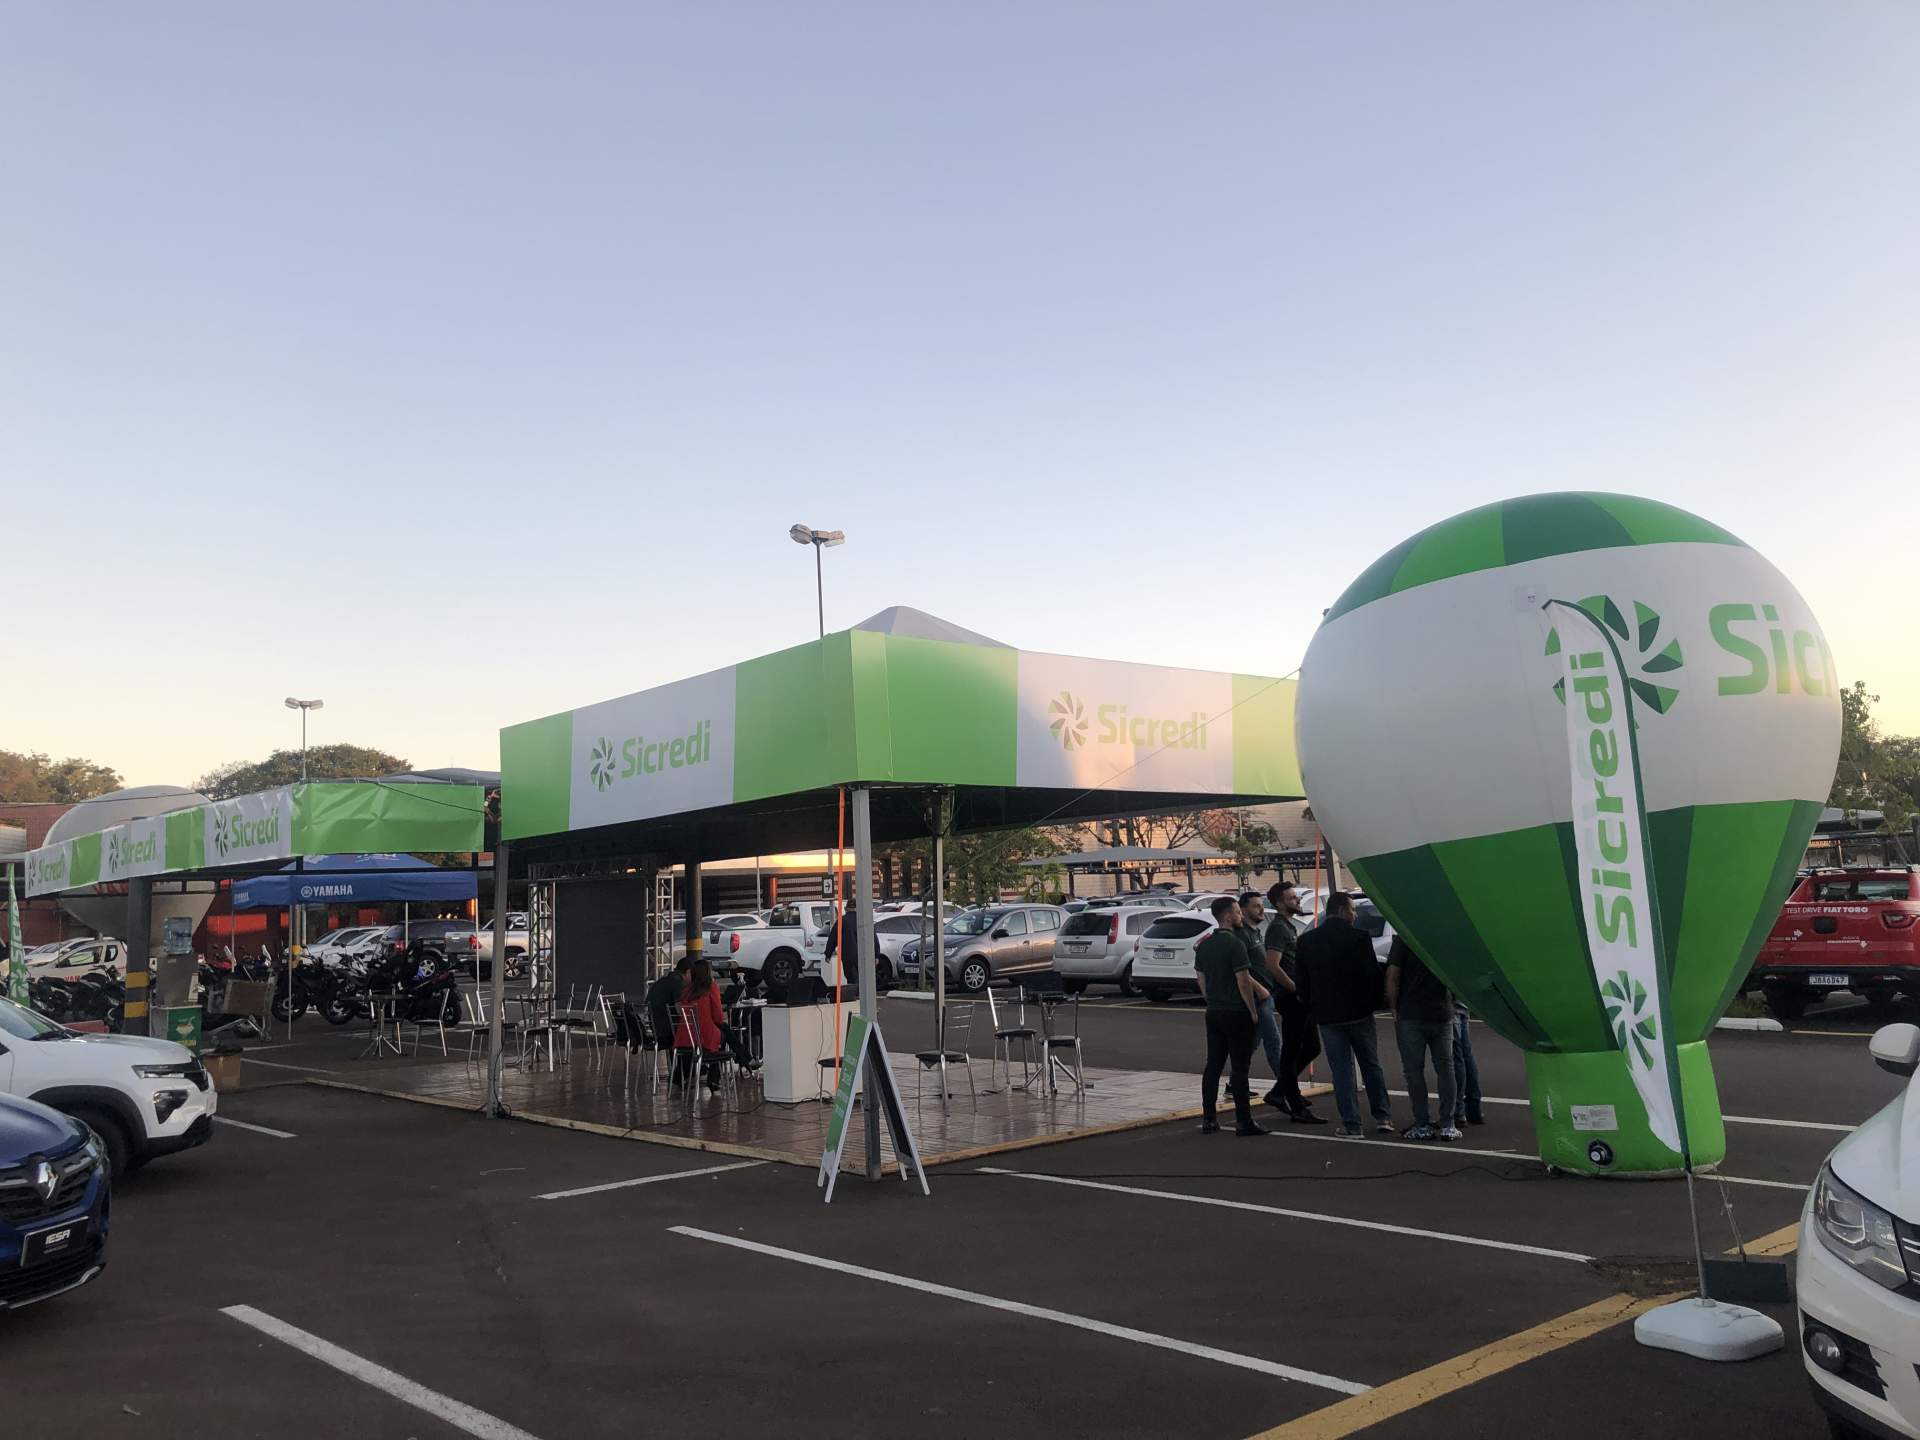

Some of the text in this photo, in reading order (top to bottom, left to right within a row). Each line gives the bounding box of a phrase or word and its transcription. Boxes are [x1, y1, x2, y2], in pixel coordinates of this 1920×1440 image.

[1097, 703, 1208, 751] Sicredi
[620, 719, 711, 780] Sicredi
[1569, 651, 1638, 949] Sicredi
[121, 831, 156, 867] Sredi
[231, 807, 279, 849] Sicredi
[313, 885, 353, 897] YAMAHA
[1786, 906, 1801, 914] TEST
[1802, 906, 1822, 914] DRIVE
